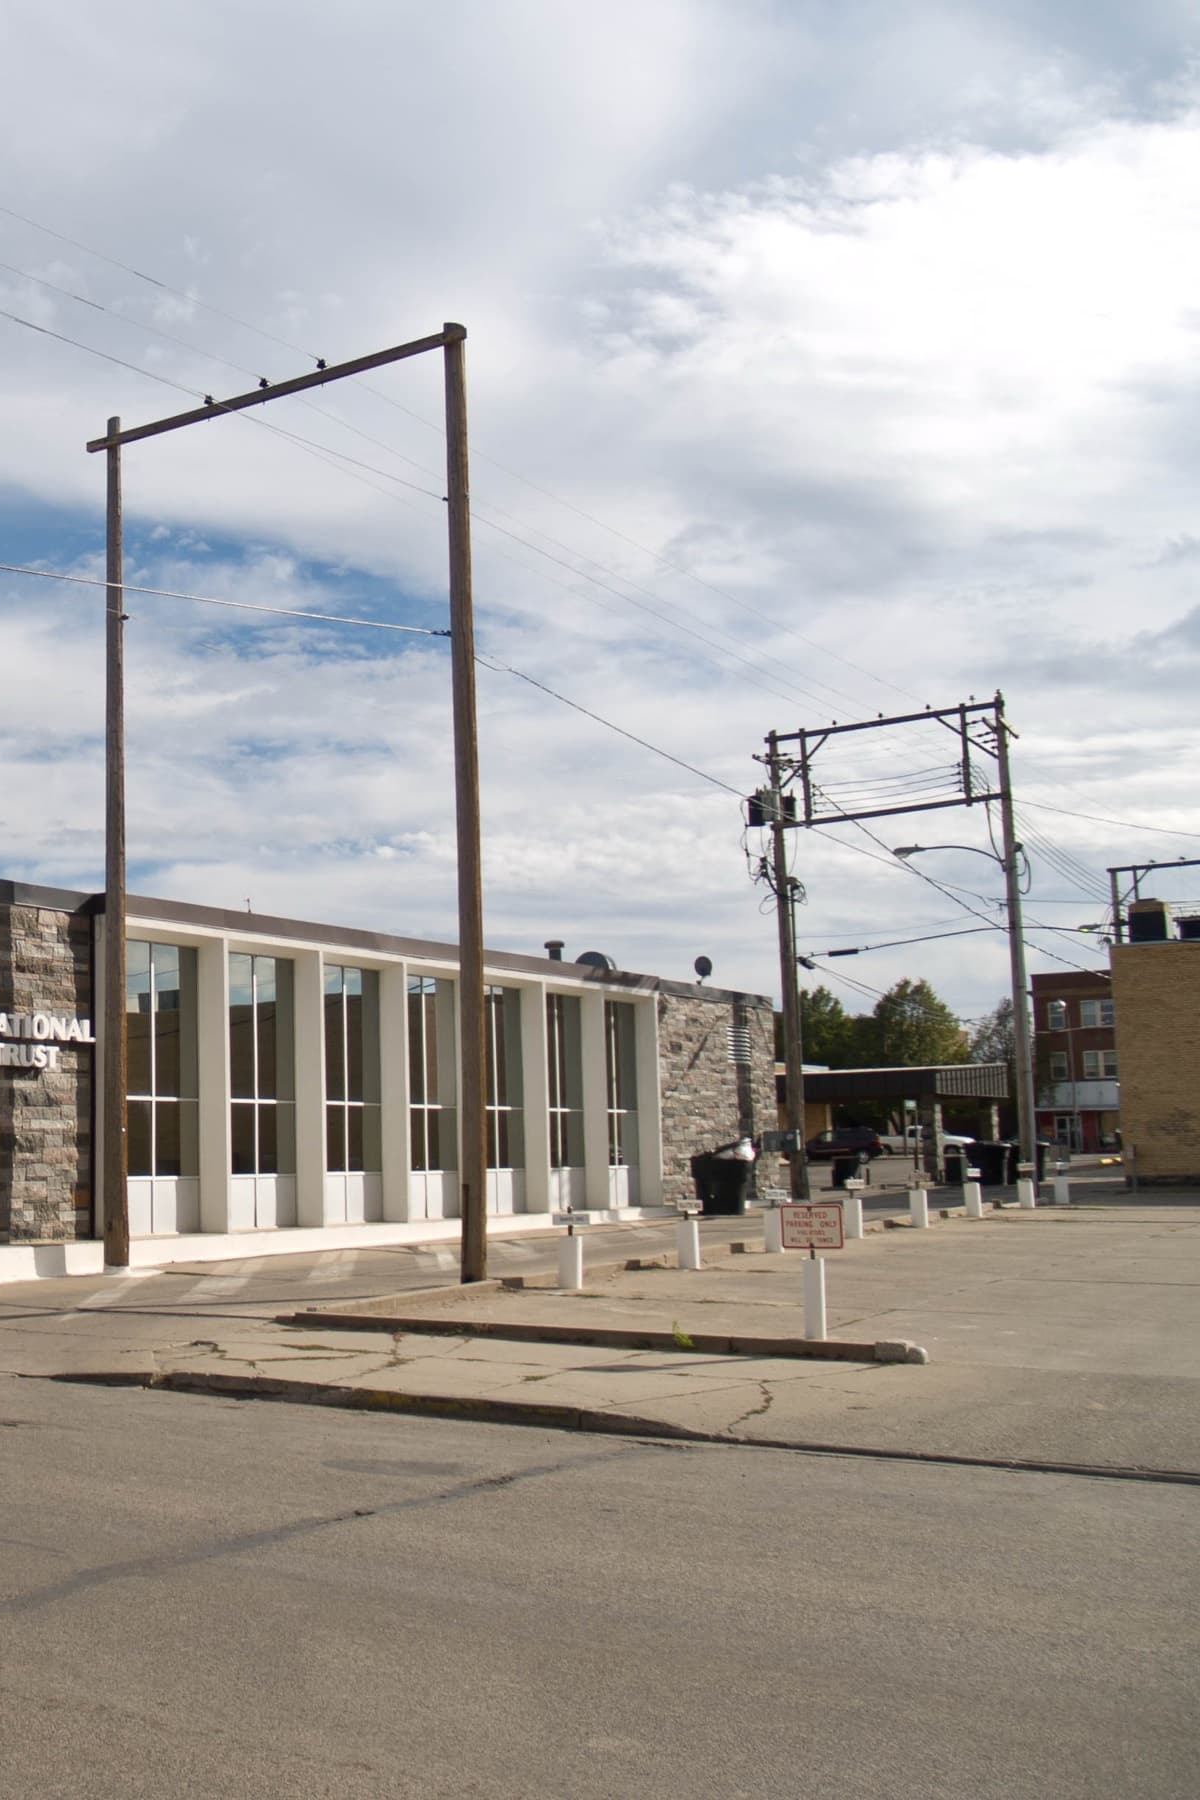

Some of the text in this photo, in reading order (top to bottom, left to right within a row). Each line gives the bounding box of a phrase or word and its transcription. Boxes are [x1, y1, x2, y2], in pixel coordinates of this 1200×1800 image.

[793, 1211, 828, 1219] RESERVED
[785, 1220, 837, 1228] PARKING ONLY
